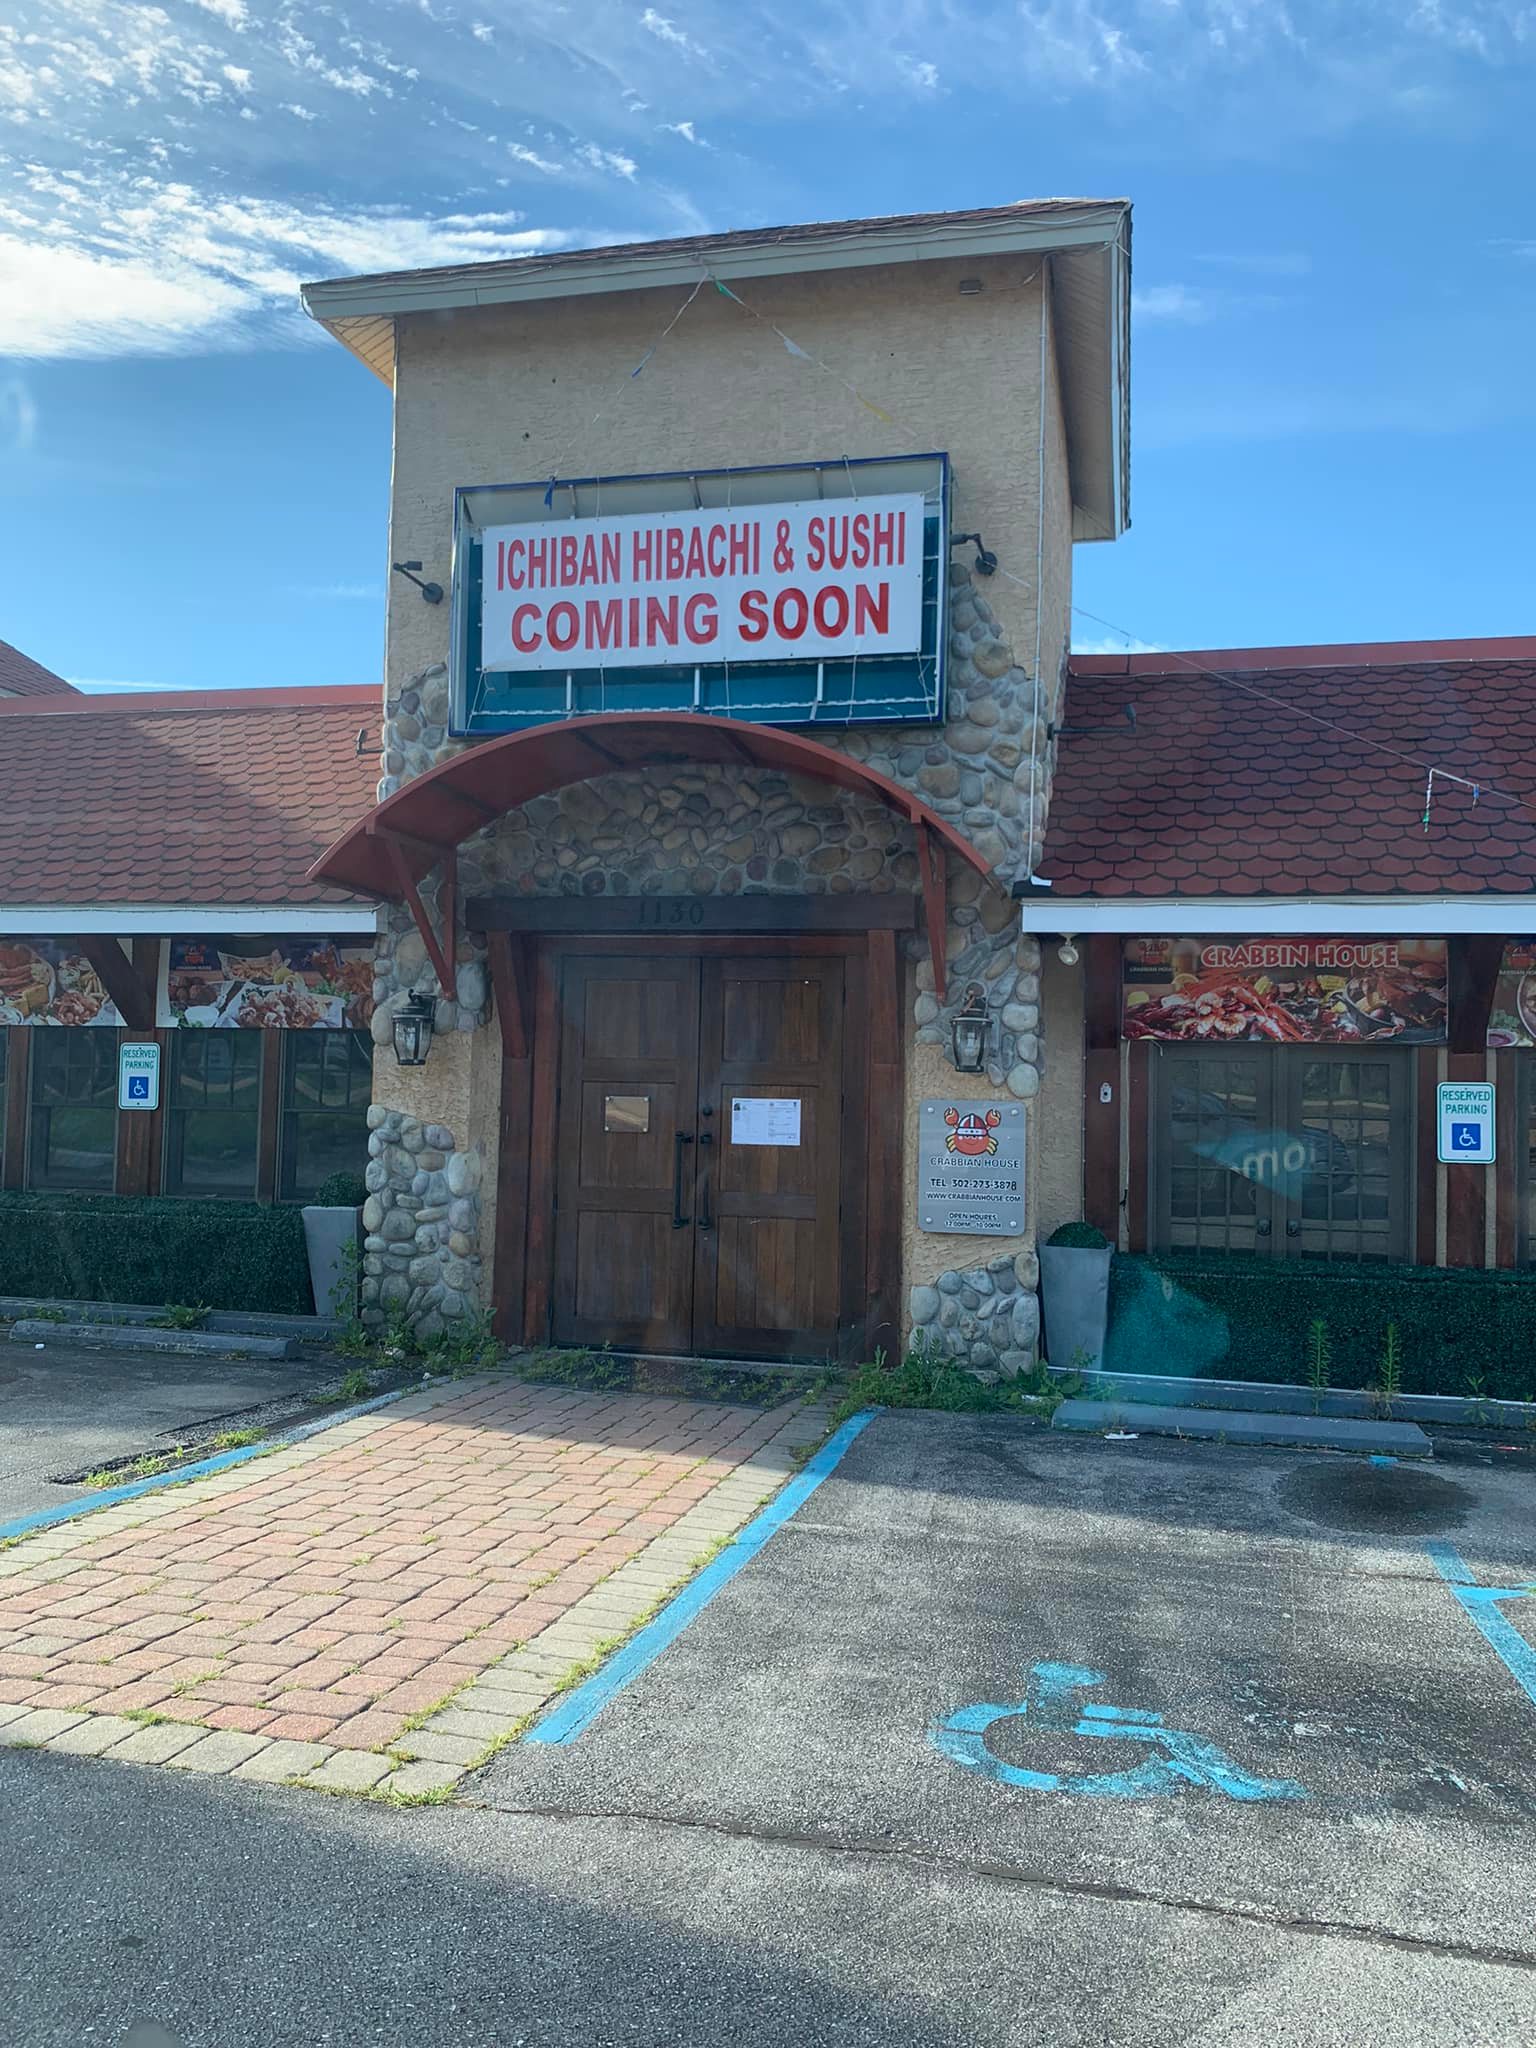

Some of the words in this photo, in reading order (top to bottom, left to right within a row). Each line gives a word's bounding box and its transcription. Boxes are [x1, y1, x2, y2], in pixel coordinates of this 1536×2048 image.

[497, 532, 621, 591] ICHIBAN
[632, 521, 760, 582] HIBACHI
[773, 519, 794, 574] &
[807, 511, 905, 572] SUSHI
[511, 592, 719, 653] COMING
[738, 582, 889, 642] SOON
[1200, 944, 1308, 968] CRABBIN
[1315, 944, 1398, 968] HOUSE
[124, 1050, 156, 1058] RESERVED
[125, 1060, 154, 1069] PARKING
[1442, 1090, 1490, 1101] RESERVED
[1445, 1104, 1487, 1115] PARKING
[930, 1157, 981, 1167] CRABBIAN
[984, 1159, 1020, 1169] HOUSE
[931, 1179, 946, 1187] TEL
